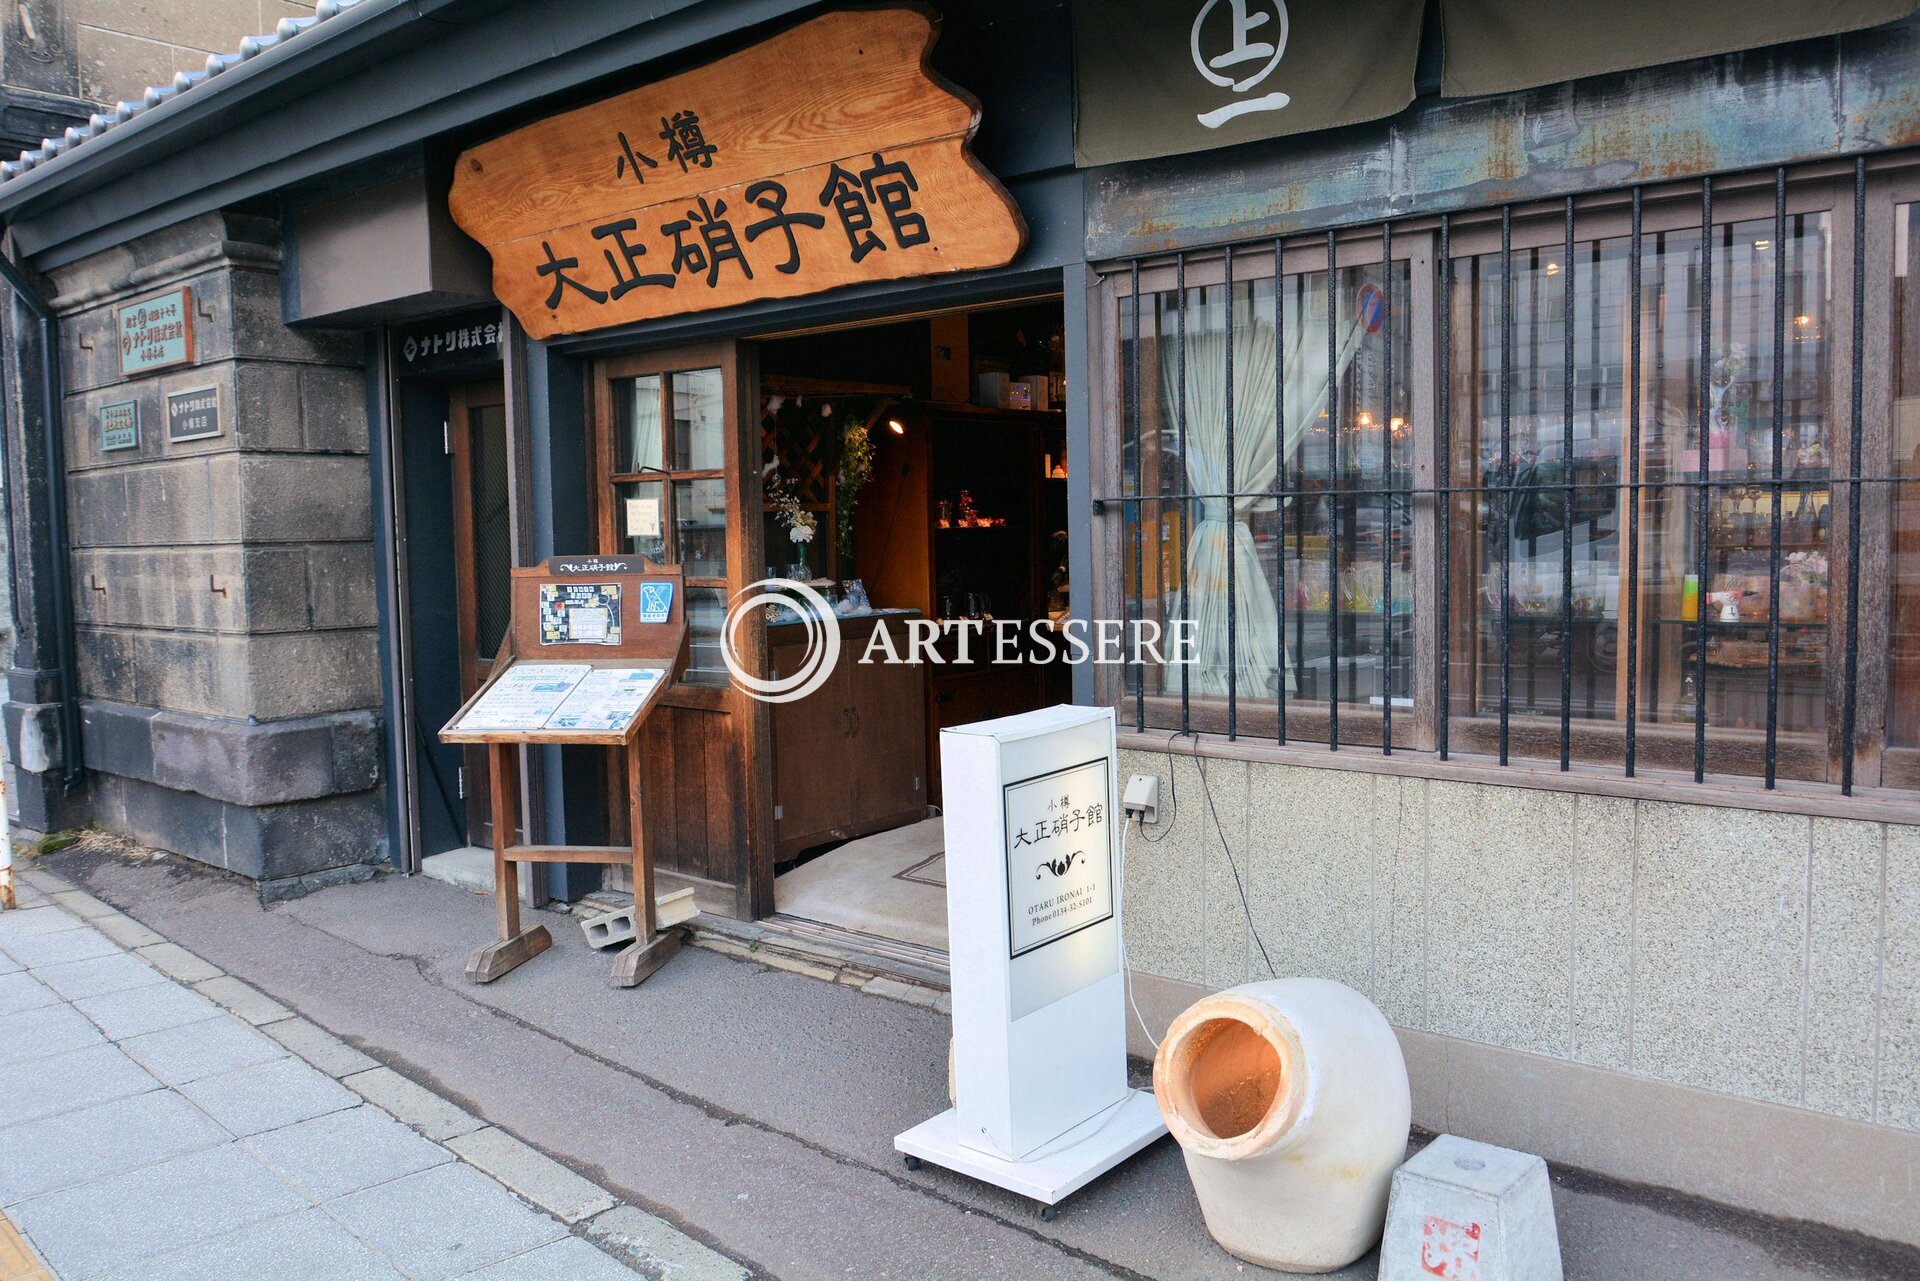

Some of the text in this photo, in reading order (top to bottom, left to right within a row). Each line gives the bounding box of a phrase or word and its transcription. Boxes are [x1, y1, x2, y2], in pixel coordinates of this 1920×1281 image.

[617, 110, 717, 185] 小樽
[536, 153, 930, 309] 大正硝子館
[1047, 794, 1070, 812] 小樽
[1014, 803, 1103, 849] 大正硝子館
[1028, 883, 1096, 915] OTARU IRONAI 1-1
[1032, 913, 1052, 926] Phone
